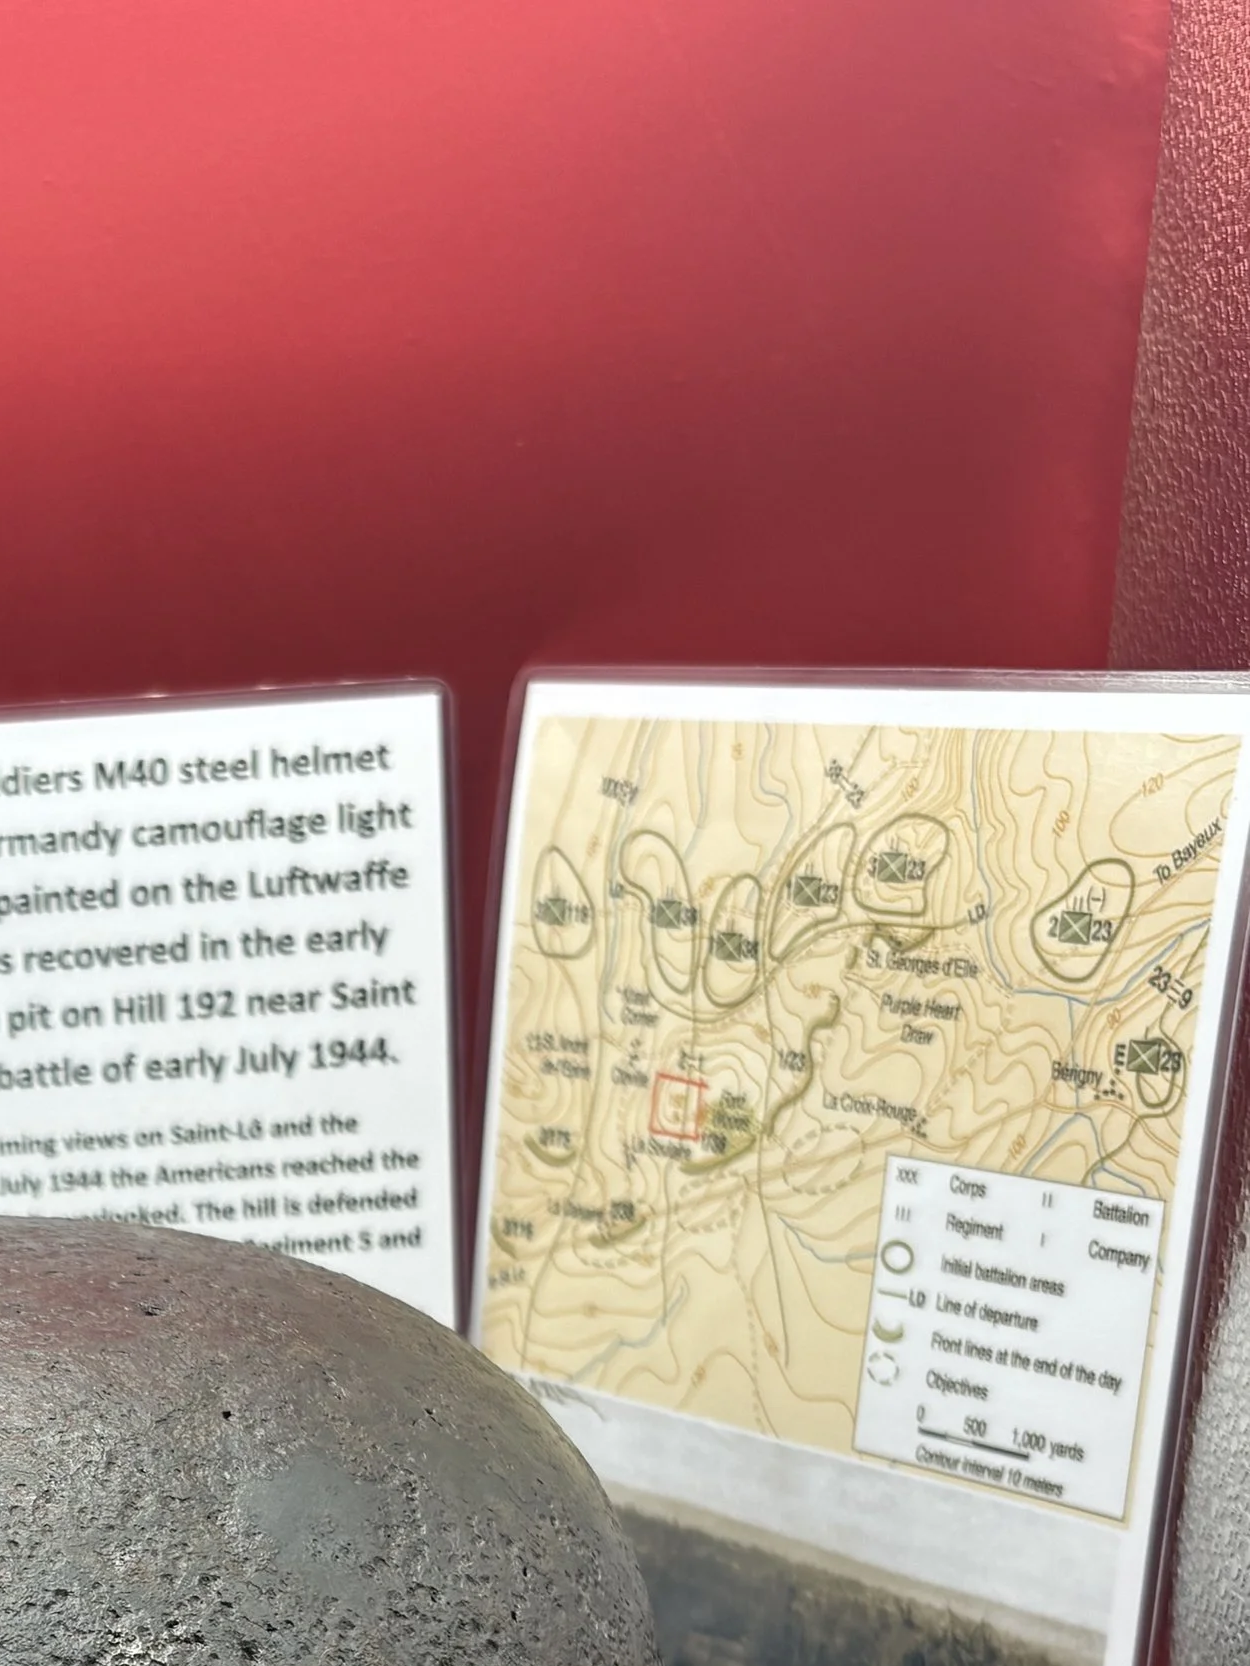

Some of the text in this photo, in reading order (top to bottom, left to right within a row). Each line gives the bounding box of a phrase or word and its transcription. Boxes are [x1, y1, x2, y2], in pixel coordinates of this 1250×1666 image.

[95, 758, 168, 791] M40
[178, 751, 259, 785] steel
[270, 743, 391, 779] helmet
[132, 809, 326, 850] camouflage
[338, 801, 413, 840] light
[1153, 818, 1222, 884] To Bayeux
[130, 880, 172, 907] on
[185, 870, 238, 903] the
[249, 859, 409, 899] Luftwaffe
[907, 859, 925, 880] 23
[821, 885, 839, 903] 23
[23, 936, 189, 972] recovered
[201, 932, 232, 961] in
[242, 926, 296, 959] the
[307, 921, 389, 960] early
[1048, 917, 1112, 941] 2 23
[887, 952, 939, 978] Georges
[1149, 966, 1171, 993] 23
[8, 1000, 51, 1039] pit
[62, 1002, 102, 1028] on
[113, 995, 166, 1025] Hill
[178, 990, 236, 1021] 192
[247, 987, 321, 1017] near
[331, 978, 416, 1013] Saint
[881, 993, 961, 1020] Purple Heart
[901, 1024, 934, 1045] Draw
[102, 1053, 134, 1082] of
[145, 1047, 225, 1084] early
[234, 1042, 299, 1078] July
[310, 1038, 398, 1070] 1944.
[64, 1130, 128, 1151] views
[134, 1130, 163, 1147] on
[270, 1116, 313, 1137] and
[321, 1113, 359, 1133] the
[49, 1170, 104, 1192] 1944
[110, 1165, 148, 1187] the
[154, 1156, 275, 1185] Americans
[282, 1148, 374, 1177] reached
[380, 1146, 420, 1169] the
[194, 1202, 236, 1223] The
[242, 1197, 277, 1219] hill
[282, 1194, 303, 1216] is
[308, 1188, 418, 1215] defended
[949, 1175, 988, 1200] Corps
[946, 1213, 1005, 1240] Regiment
[1092, 1200, 1151, 1227] Battalion
[379, 1227, 421, 1249] and
[1088, 1240, 1151, 1272] Company
[941, 1255, 1066, 1297] Initial battalion areas
[909, 1289, 1039, 1333] LD Line of departure
[931, 1331, 1122, 1396] Front lines at the end of the day
[926, 1369, 989, 1400] Objectives
[964, 1416, 987, 1437] 500
[1012, 1427, 1046, 1451] 1,000
[1049, 1440, 1084, 1462] yards
[915, 1445, 1064, 1498] Contour interval 10 meters
